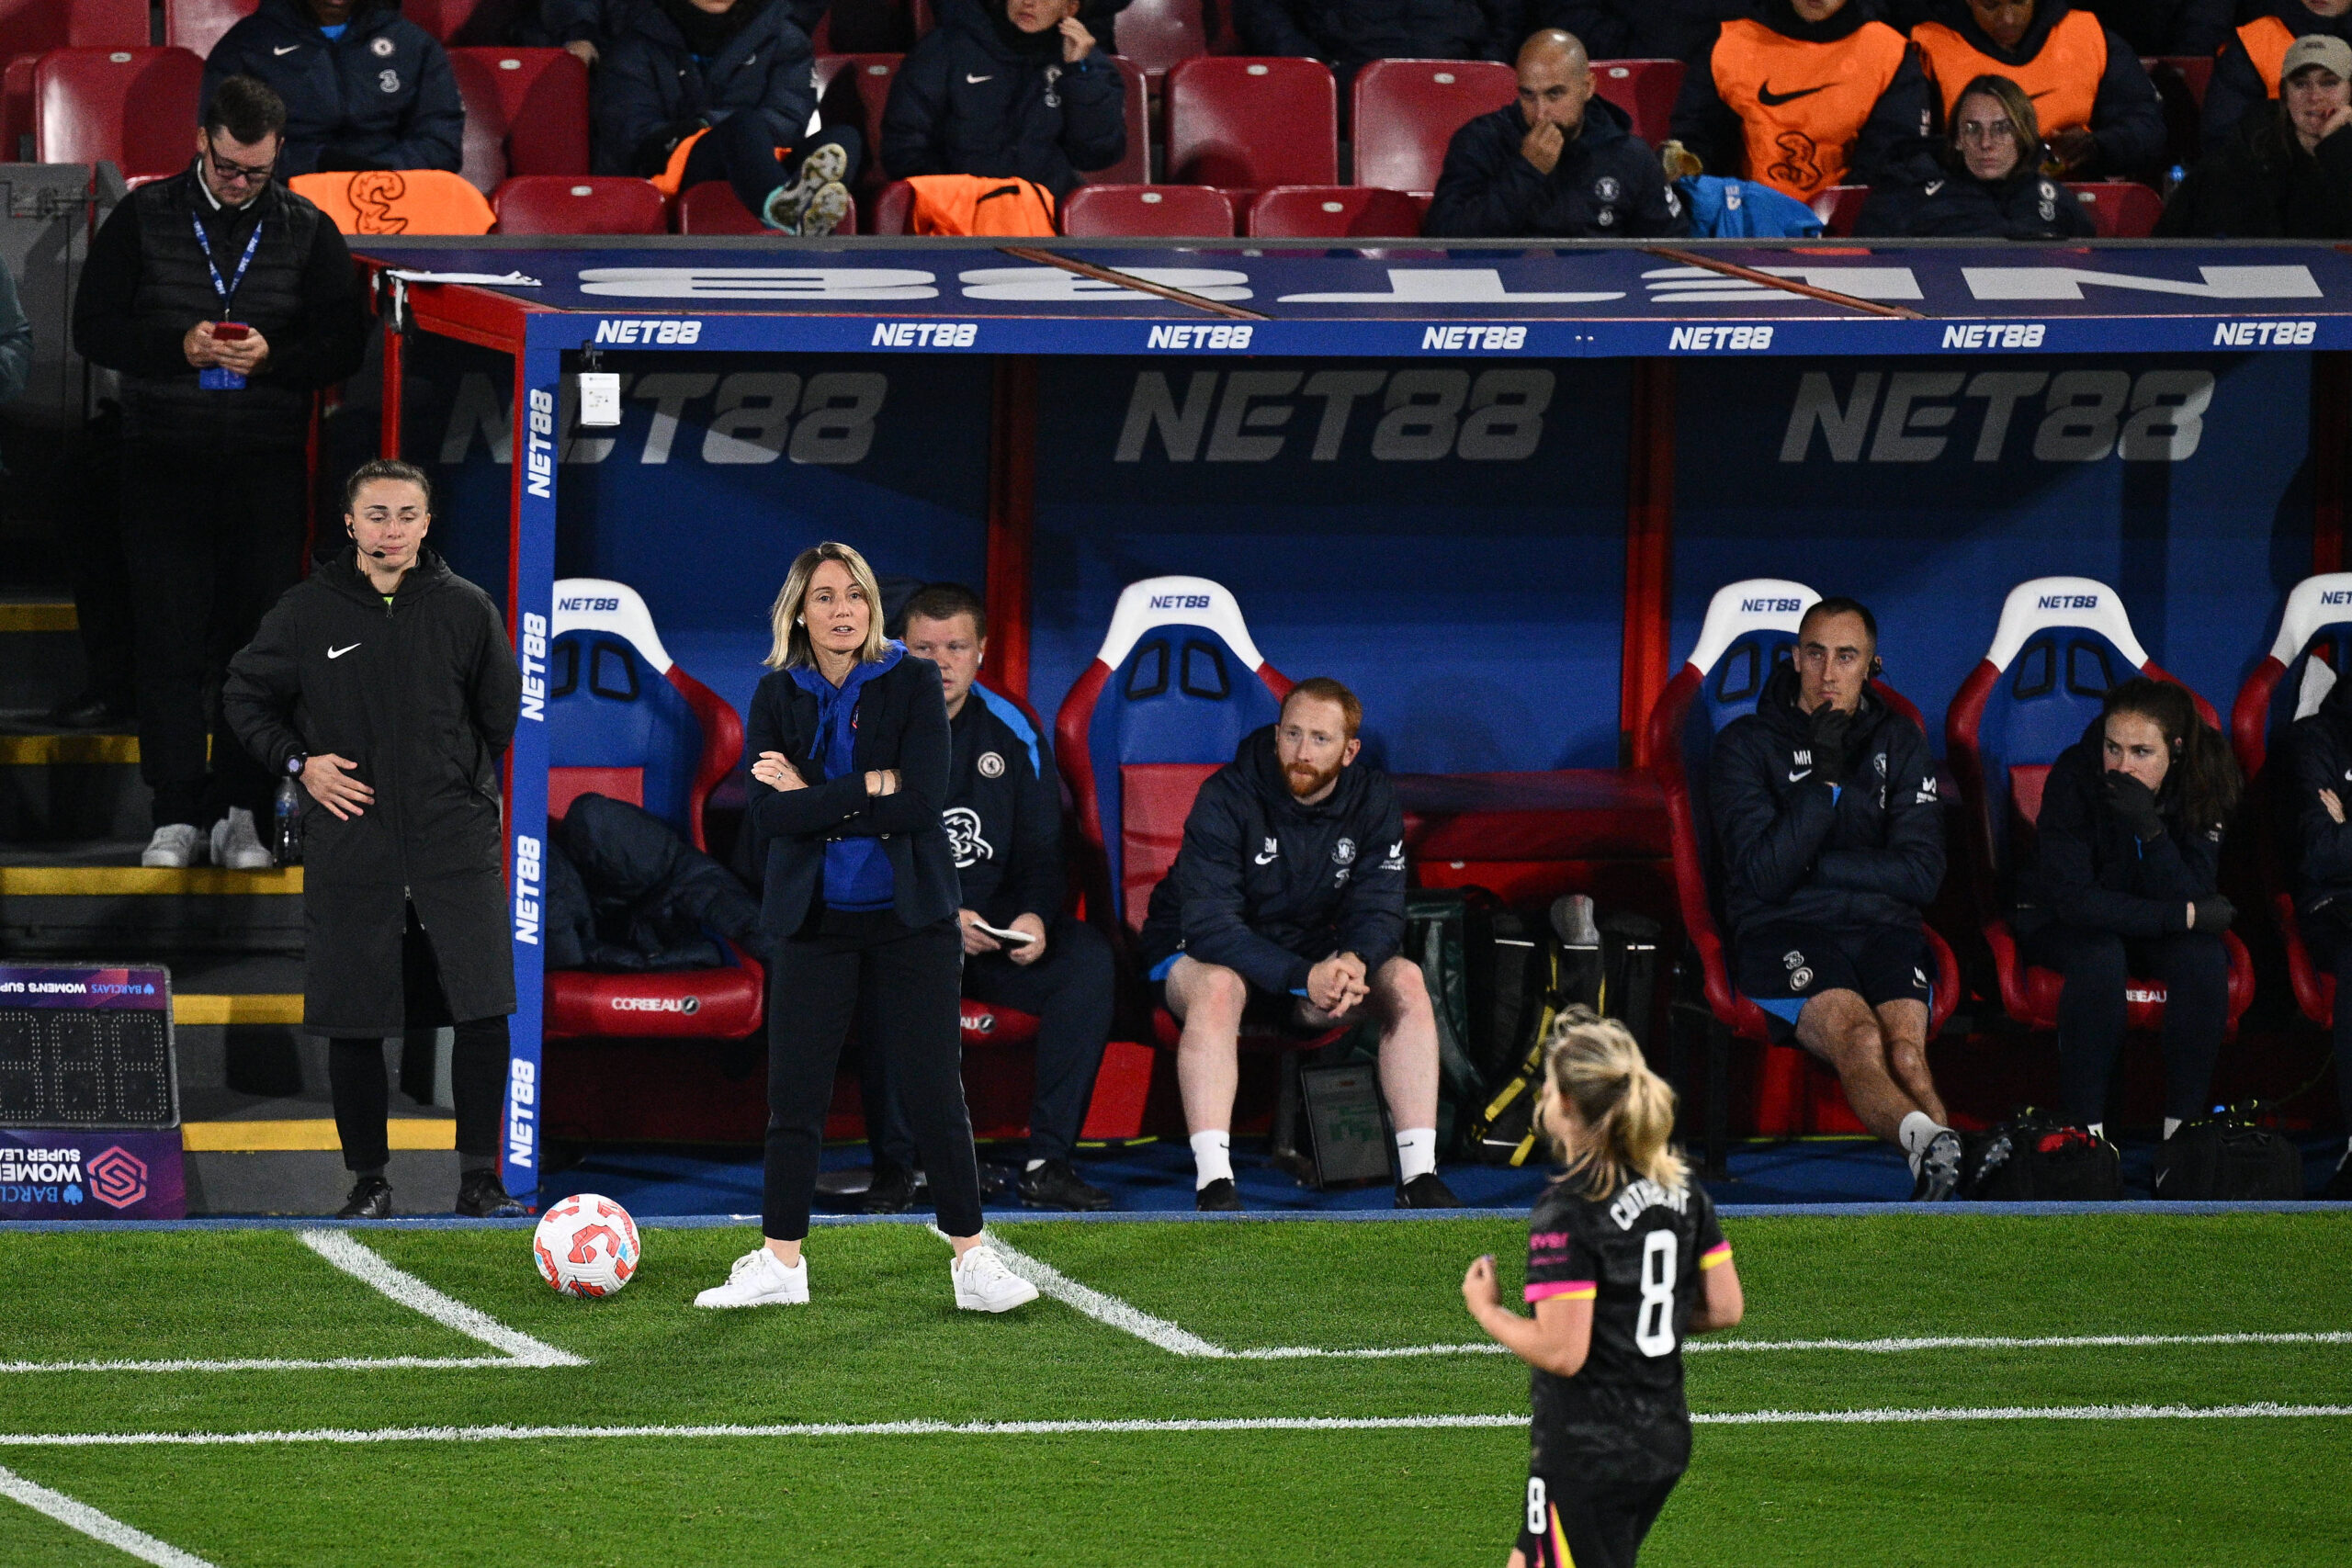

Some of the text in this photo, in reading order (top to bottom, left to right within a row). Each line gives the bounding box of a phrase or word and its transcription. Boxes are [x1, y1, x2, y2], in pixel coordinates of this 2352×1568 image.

[595, 320, 702, 344] NET88
[872, 322, 978, 347] NET88
[1148, 325, 1254, 349] NET88
[1422, 326, 1528, 350] NET88
[1669, 326, 1774, 350] NET88
[1941, 324, 2046, 348] NET88
[2212, 321, 2317, 346] NET88
[1114, 368, 1557, 463] NET88
[1779, 369, 2216, 463] NET88
[527, 389, 552, 499] NET88
[558, 597, 619, 612] NET88
[1149, 594, 1210, 610] NET88
[1741, 598, 1802, 613] NET88
[2038, 595, 2098, 610] NET88
[521, 612, 547, 722] NET88
[1793, 750, 1812, 765] MH
[515, 834, 541, 945] NET88
[28, 982, 87, 994] WOMEN'S
[92, 983, 142, 995] BARCLAYS
[611, 997, 682, 1012] CORBEAU
[509, 1057, 535, 1168] NET88
[28, 1148, 81, 1163] SUPER
[0, 1163, 83, 1183] WOME
[1635, 1228, 1678, 1357] 8
[1527, 1477, 1547, 1536] 8
